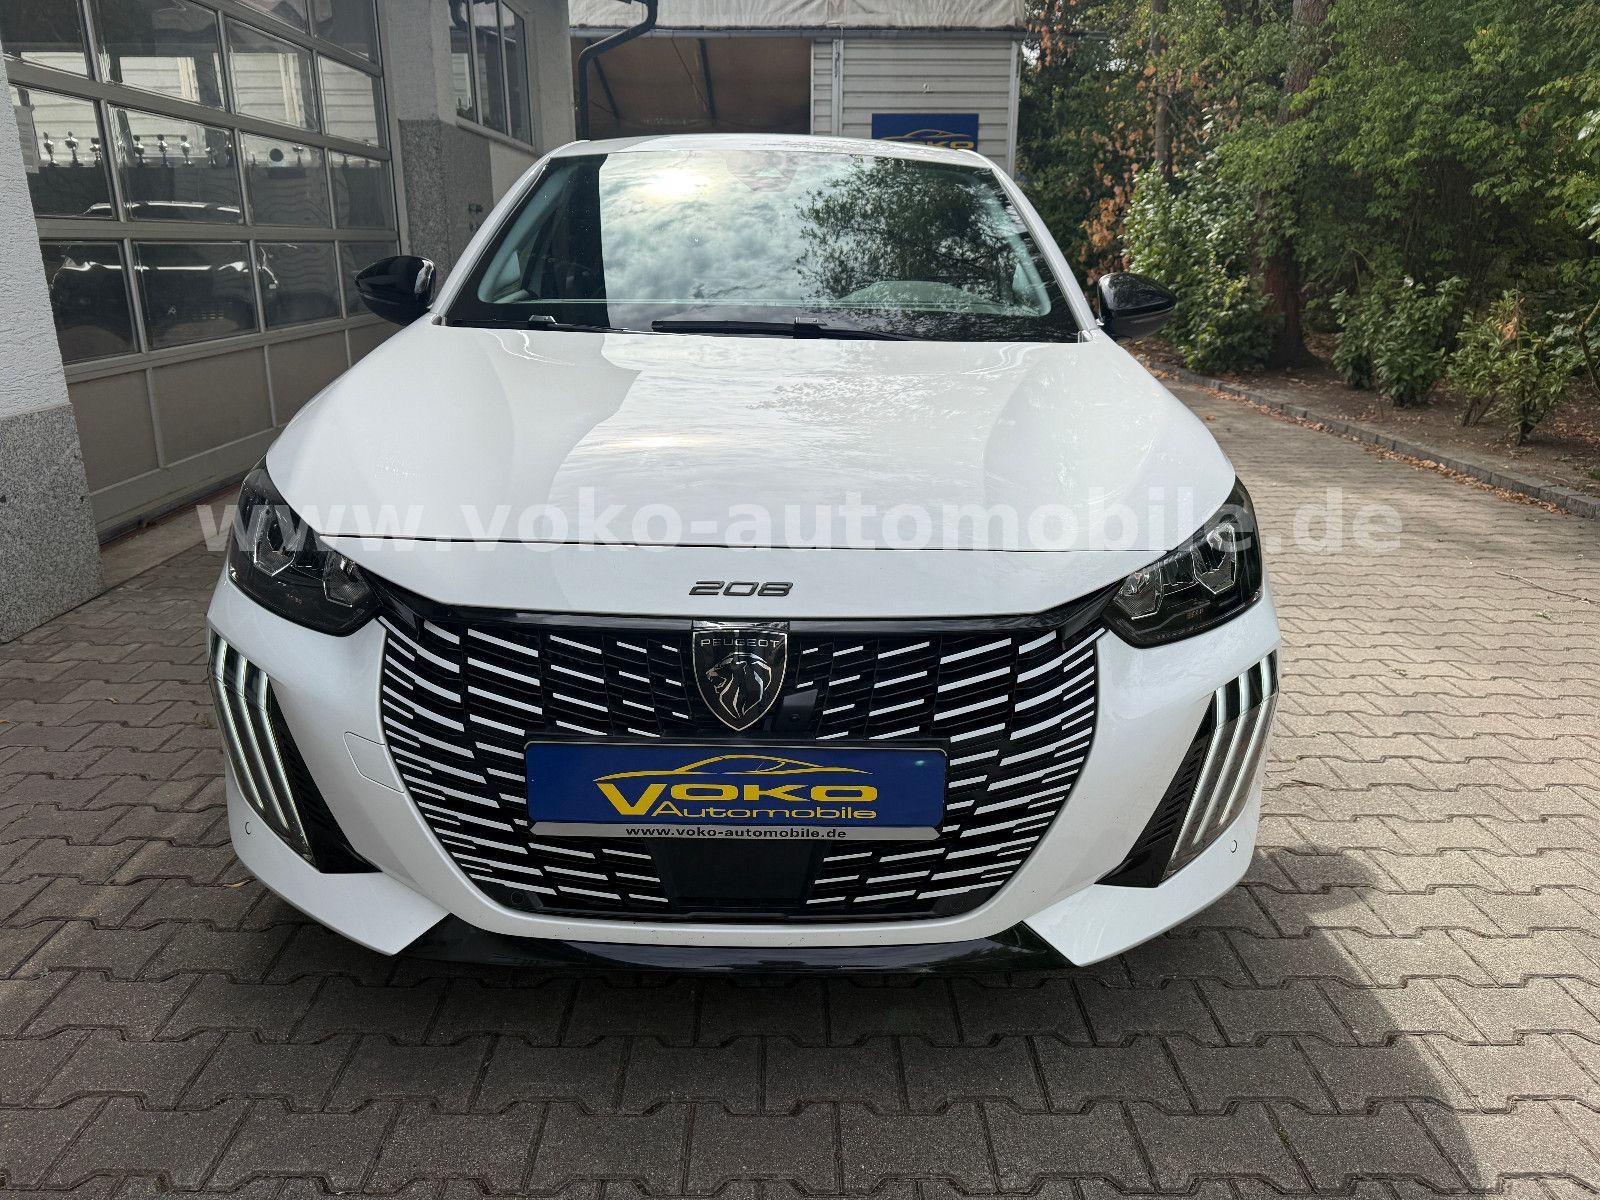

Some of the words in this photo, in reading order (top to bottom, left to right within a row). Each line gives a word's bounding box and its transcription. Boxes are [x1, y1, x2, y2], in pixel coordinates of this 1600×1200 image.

[689, 581, 793, 596] 208
[701, 639, 780, 648] PEUGEOT
[650, 800, 877, 819] Automobile
[626, 826, 847, 839] www.voko-automobile.de
